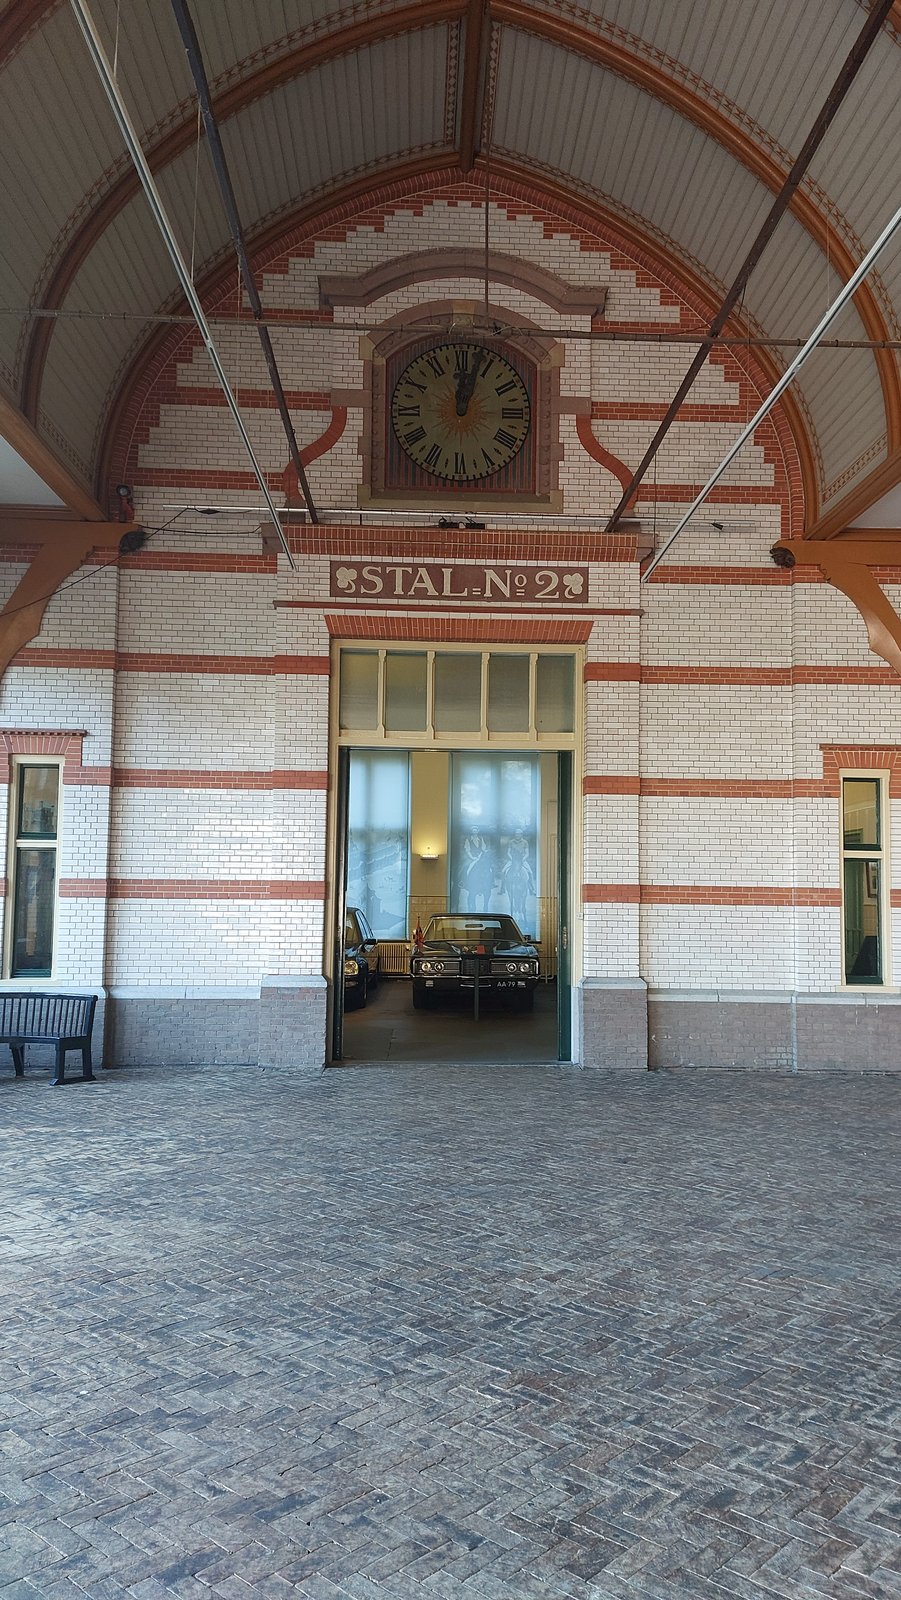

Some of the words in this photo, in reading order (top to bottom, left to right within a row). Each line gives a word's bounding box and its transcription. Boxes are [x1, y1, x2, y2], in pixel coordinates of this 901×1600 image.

[426, 356, 445, 379] XI
[455, 350, 468, 371] XII
[406, 377, 427, 394] X
[495, 379, 517, 397] II
[398, 404, 420, 416] IX
[502, 407, 523, 419] III
[424, 443, 442, 467] VII
[454, 452, 466, 474] VI
[481, 447, 495, 468] V
[534, 570, 559, 599] 2
